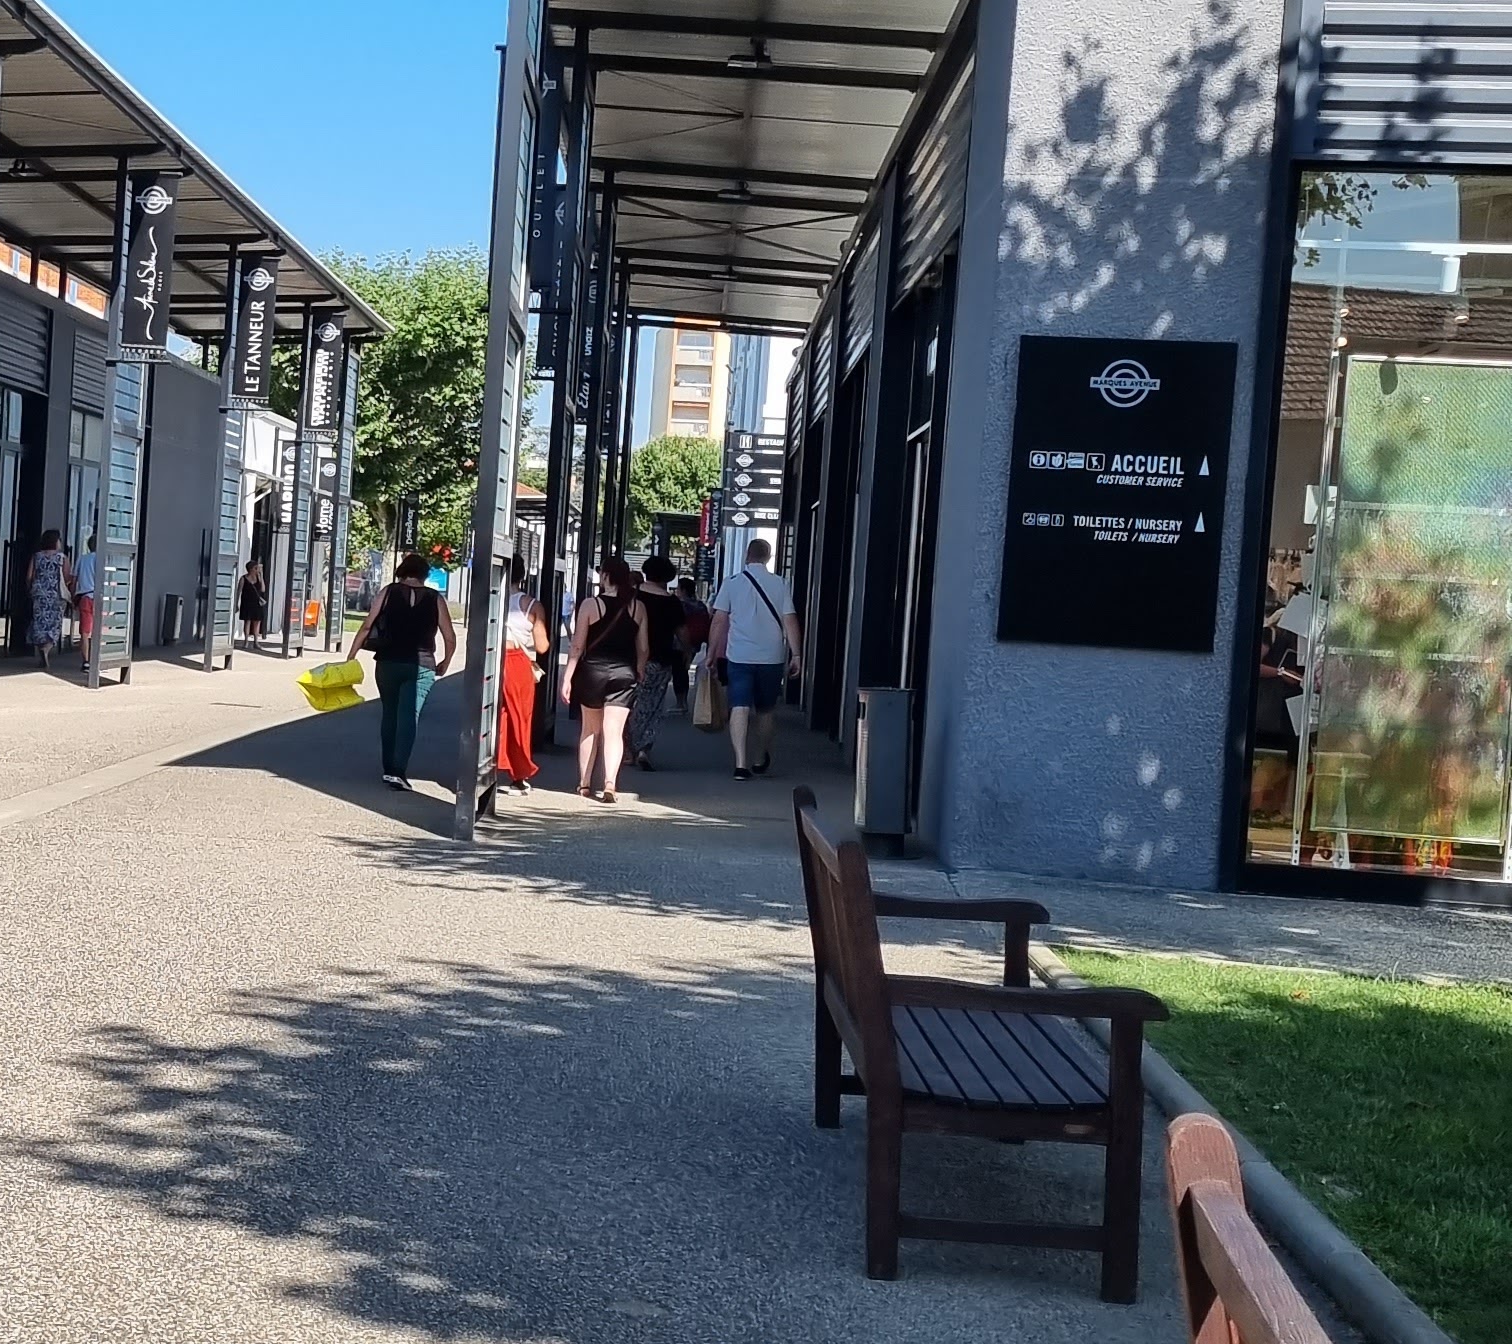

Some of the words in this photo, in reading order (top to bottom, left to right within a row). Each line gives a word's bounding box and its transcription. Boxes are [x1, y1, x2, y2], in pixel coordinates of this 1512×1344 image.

[532, 152, 546, 239] OUTLET
[244, 300, 266, 375] TANNEUR
[244, 376, 261, 392] LE
[1092, 378, 1128, 388] MARQUES
[1129, 379, 1158, 389] AVENUE
[1110, 454, 1185, 475] ACCUEIL
[1096, 473, 1144, 486] CUSTOMER
[1145, 476, 1184, 488] SERVICE
[1073, 515, 1126, 529] TOILETTES
[1127, 518, 1133, 529] /
[1134, 518, 1183, 532] NURSERY
[1093, 530, 1129, 542] TOILETS
[1138, 532, 1180, 544] NURSERY
